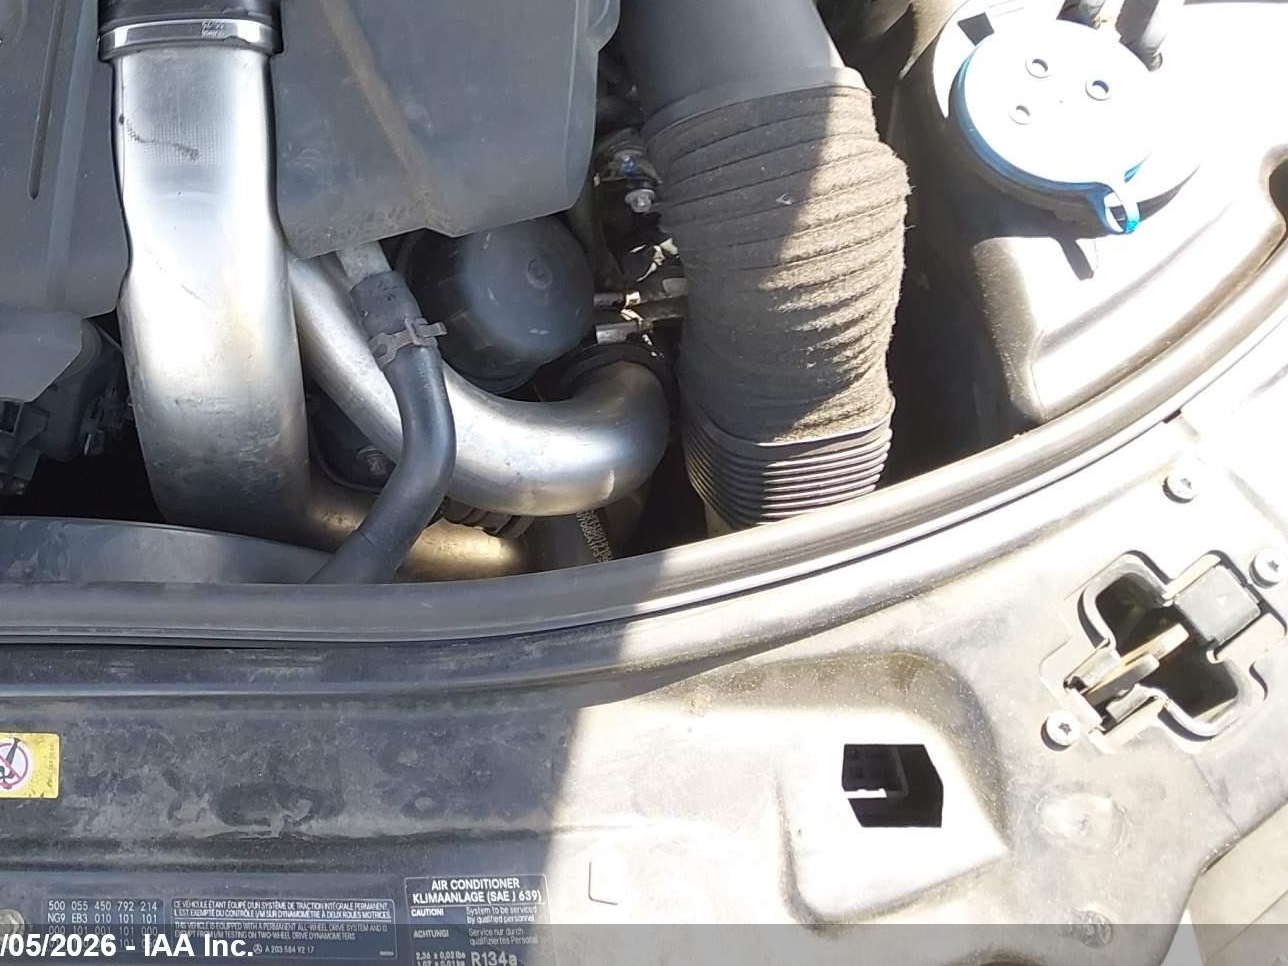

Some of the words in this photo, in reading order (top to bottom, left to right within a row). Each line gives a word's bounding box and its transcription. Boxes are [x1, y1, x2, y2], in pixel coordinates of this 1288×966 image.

[431, 880, 448, 891] AIR
[450, 878, 520, 890] CONDITIONER
[412, 892, 485, 905] KLIMAANLAGE
[486, 891, 510, 904] (SAE
[518, 889, 542, 902] 639)
[48, 901, 65, 912] 500
[71, 901, 89, 912] 055
[94, 901, 111, 912] 450
[117, 901, 134, 912] 792
[140, 901, 157, 912] 214
[411, 908, 445, 917] CAUTION!
[48, 914, 65, 924] NG9
[72, 914, 87, 924] EB3
[94, 914, 111, 924] 010
[119, 914, 134, 924] 101
[142, 914, 157, 924] 101
[470, 951, 518, 966] R134a
